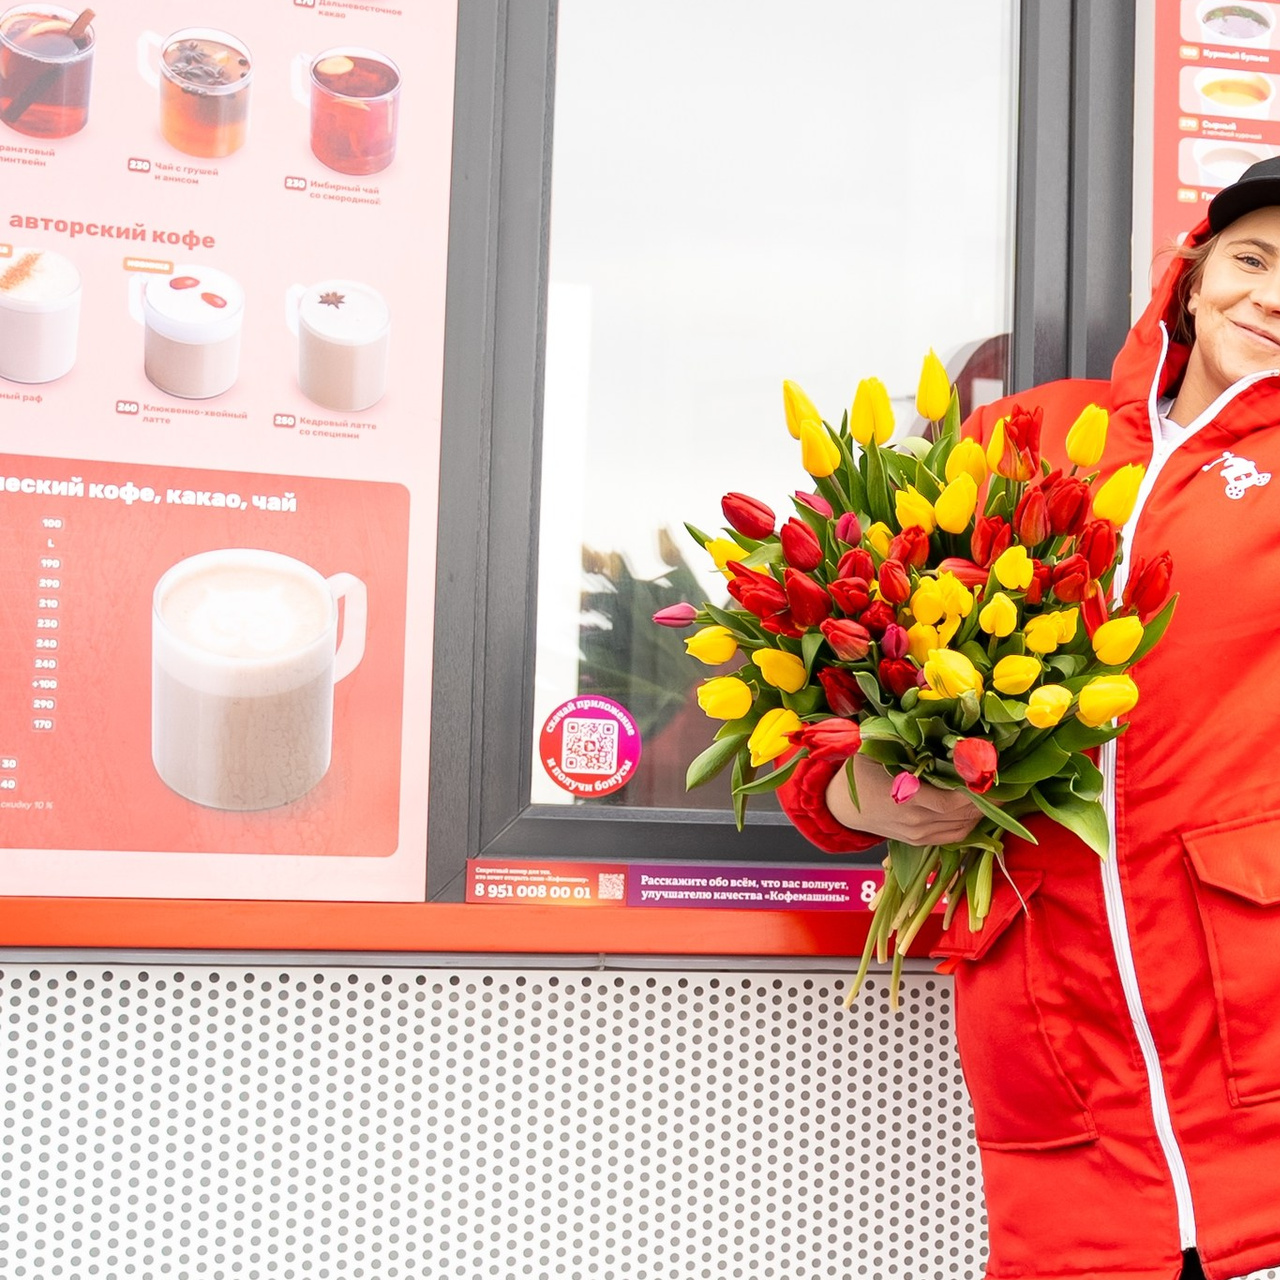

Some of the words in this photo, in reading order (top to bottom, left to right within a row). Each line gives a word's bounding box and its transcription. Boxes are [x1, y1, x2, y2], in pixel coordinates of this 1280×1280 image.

[318, 9, 346, 19] какао
[155, 162, 174, 173] Чай
[183, 166, 219, 178] грушей
[161, 175, 199, 185] анисом
[310, 180, 361, 193] Имбирный
[362, 185, 380, 195] чай
[309, 191, 321, 200] со
[9, 213, 146, 241] авторский
[152, 230, 216, 250] кофе
[22, 393, 43, 404] раф
[117, 402, 138, 413] 260
[143, 404, 248, 421] Клюквенно-хвойный
[142, 415, 171, 425] латте
[299, 416, 349, 430] Кедровый
[350, 420, 377, 431] латте
[299, 427, 311, 436] со
[312, 428, 360, 441] специями
[88, 481, 162, 506] кофе,
[166, 488, 248, 511] какао,
[251, 492, 298, 513] чай
[42, 519, 62, 529] 100
[41, 559, 60, 569] 190
[38, 579, 60, 589] 290
[38, 599, 59, 609] 210
[37, 619, 58, 629] 230
[36, 639, 57, 649] 240
[35, 659, 56, 669] 240
[33, 700, 54, 709] 290
[546, 701, 576, 733] скачай
[576, 699, 635, 737] приложение
[33, 720, 53, 729] 170
[1, 759, 17, 769] 30
[546, 757, 556, 767] и
[552, 766, 593, 792] получи
[594, 759, 633, 791] бонусы
[0, 779, 16, 789] 40
[640, 874, 707, 888] Расскажите
[708, 876, 729, 888] обо
[729, 877, 759, 890] всём,
[760, 879, 781, 889] что
[781, 879, 801, 889] вас
[801, 880, 849, 892] волнует,
[475, 882, 485, 896] 8
[488, 883, 514, 897] 951
[516, 884, 547, 898] 008
[550, 885, 571, 898] 00
[573, 886, 591, 899] 01
[860, 880, 878, 903] 8
[640, 889, 712, 902] улучшателю
[713, 890, 763, 902] качества
[764, 891, 850, 904] «Кофемашины»
